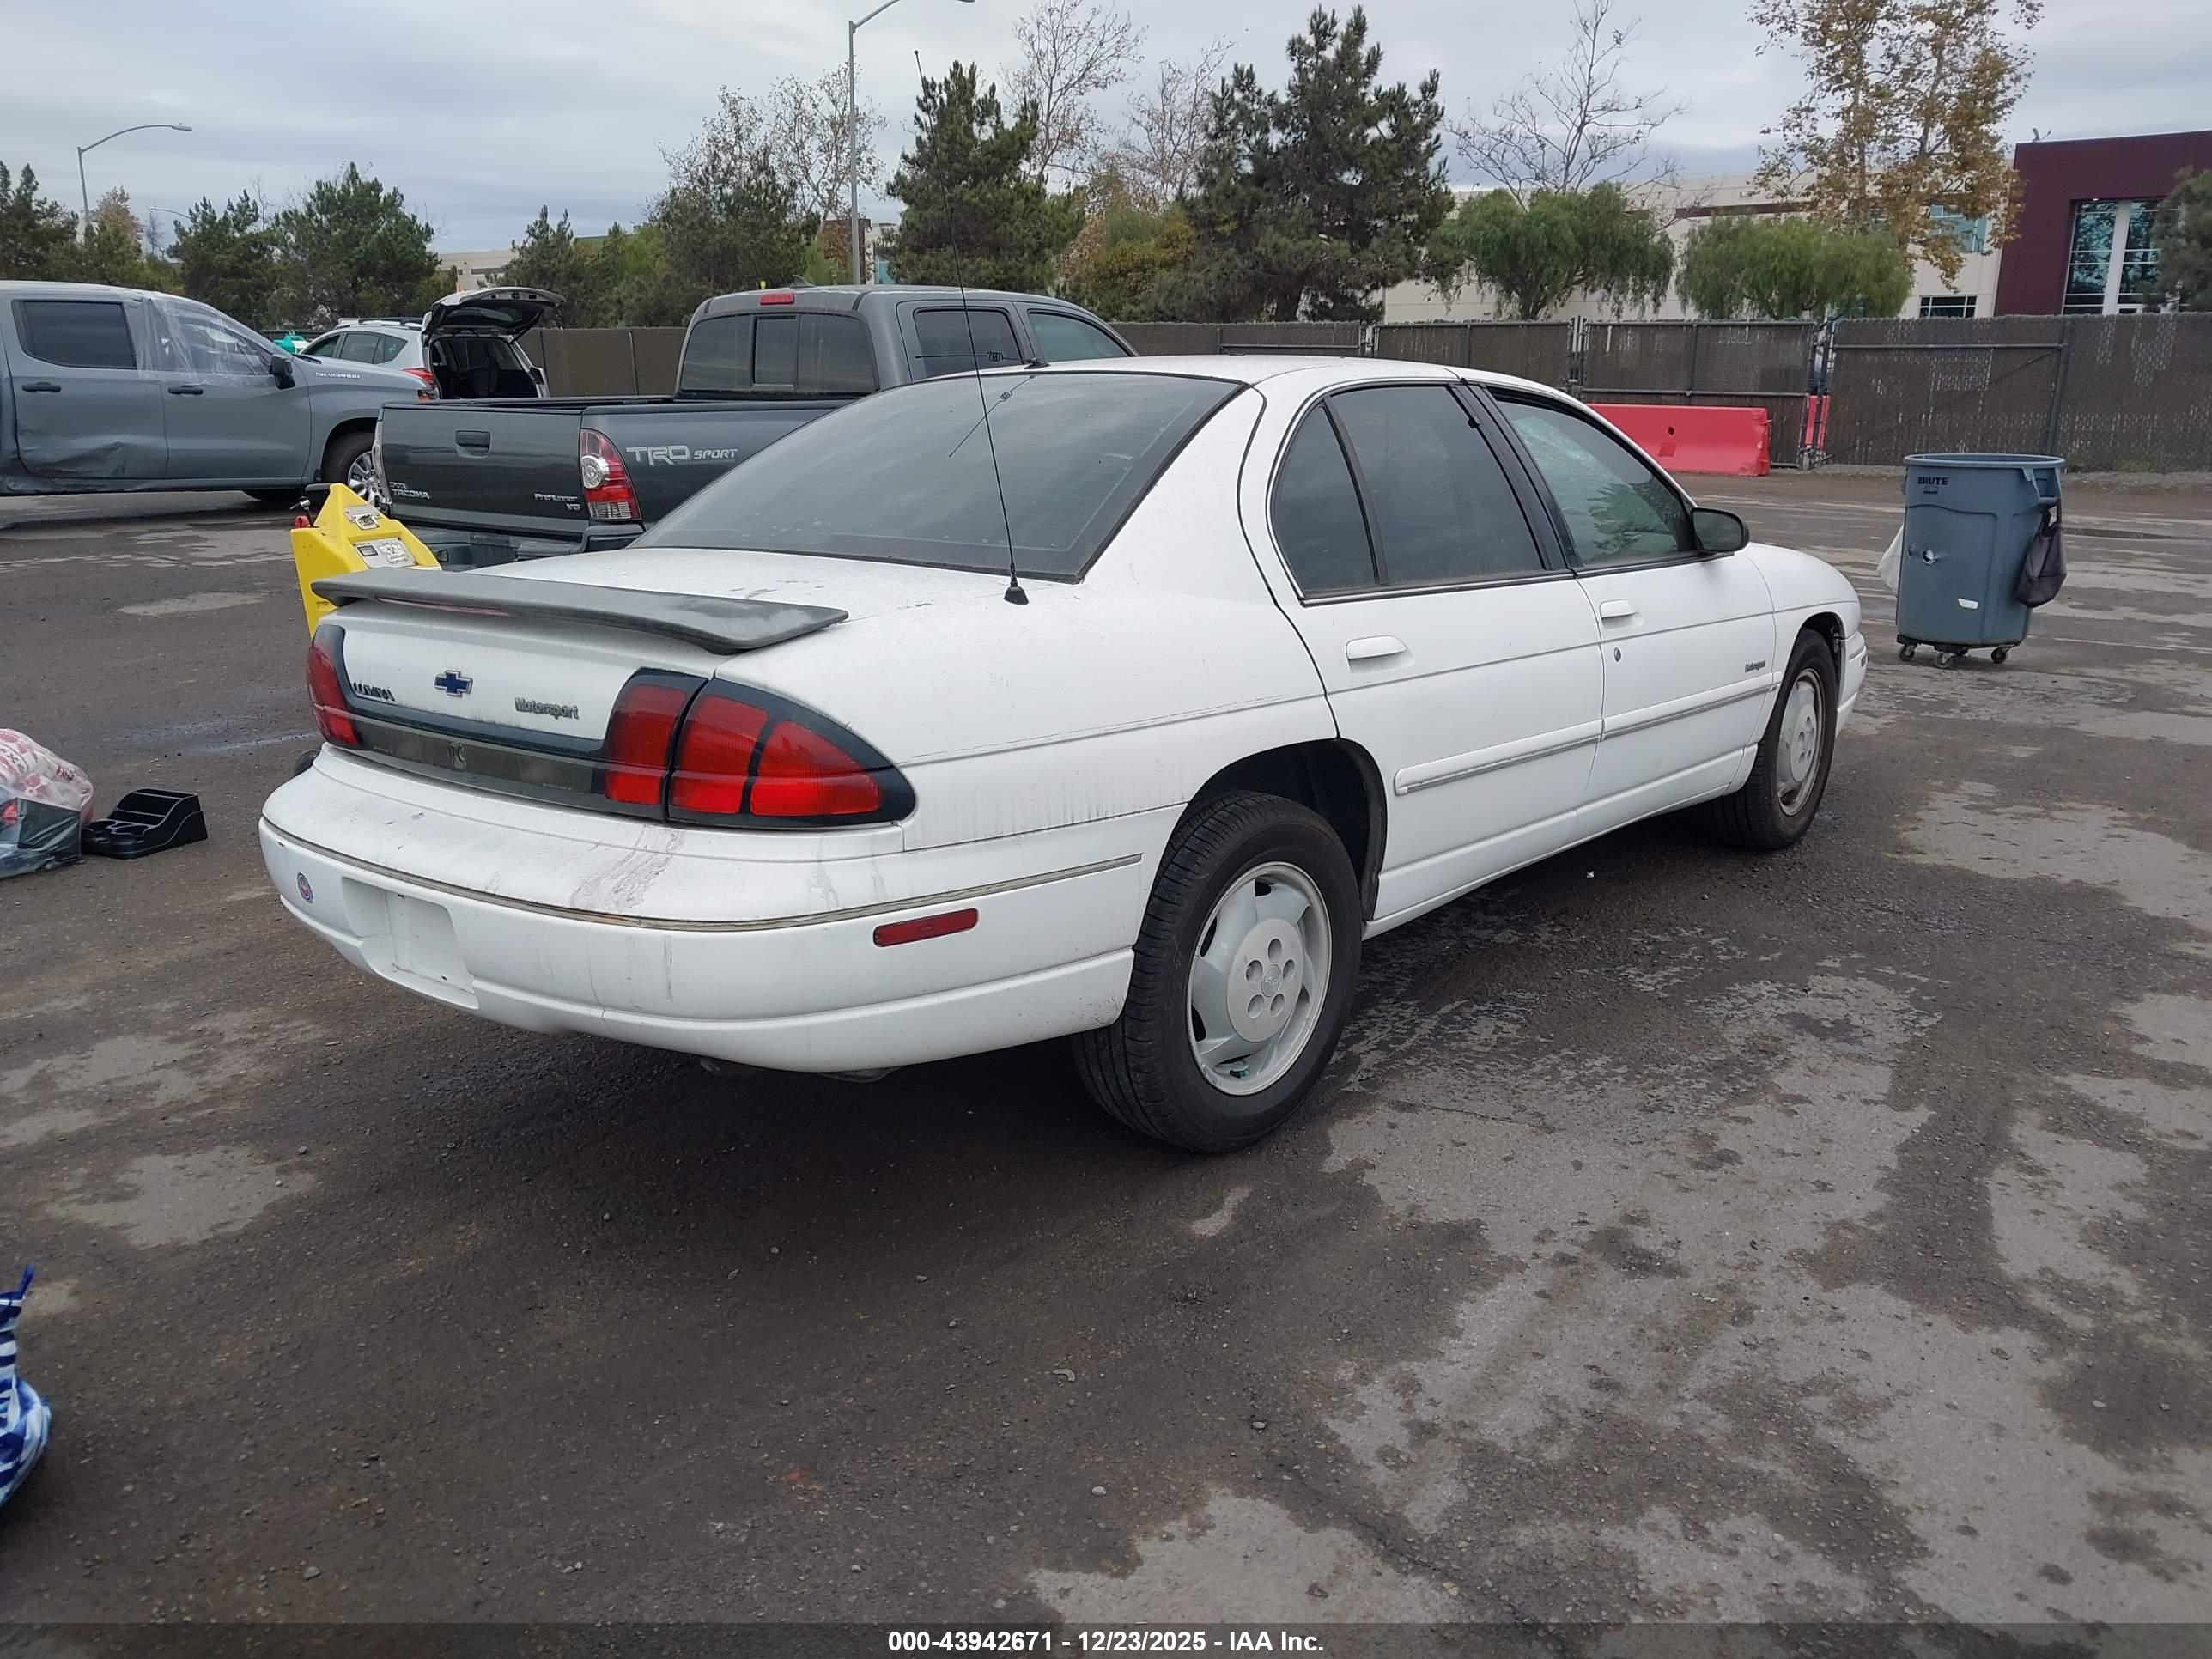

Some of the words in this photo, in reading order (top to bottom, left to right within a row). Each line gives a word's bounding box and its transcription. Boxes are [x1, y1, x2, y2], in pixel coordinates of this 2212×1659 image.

[625, 445, 690, 466] TRD
[693, 448, 738, 459] SPORT
[1917, 476, 1949, 486] BRUTE
[391, 489, 430, 500] TACOMA
[514, 696, 580, 720] Motorsport
